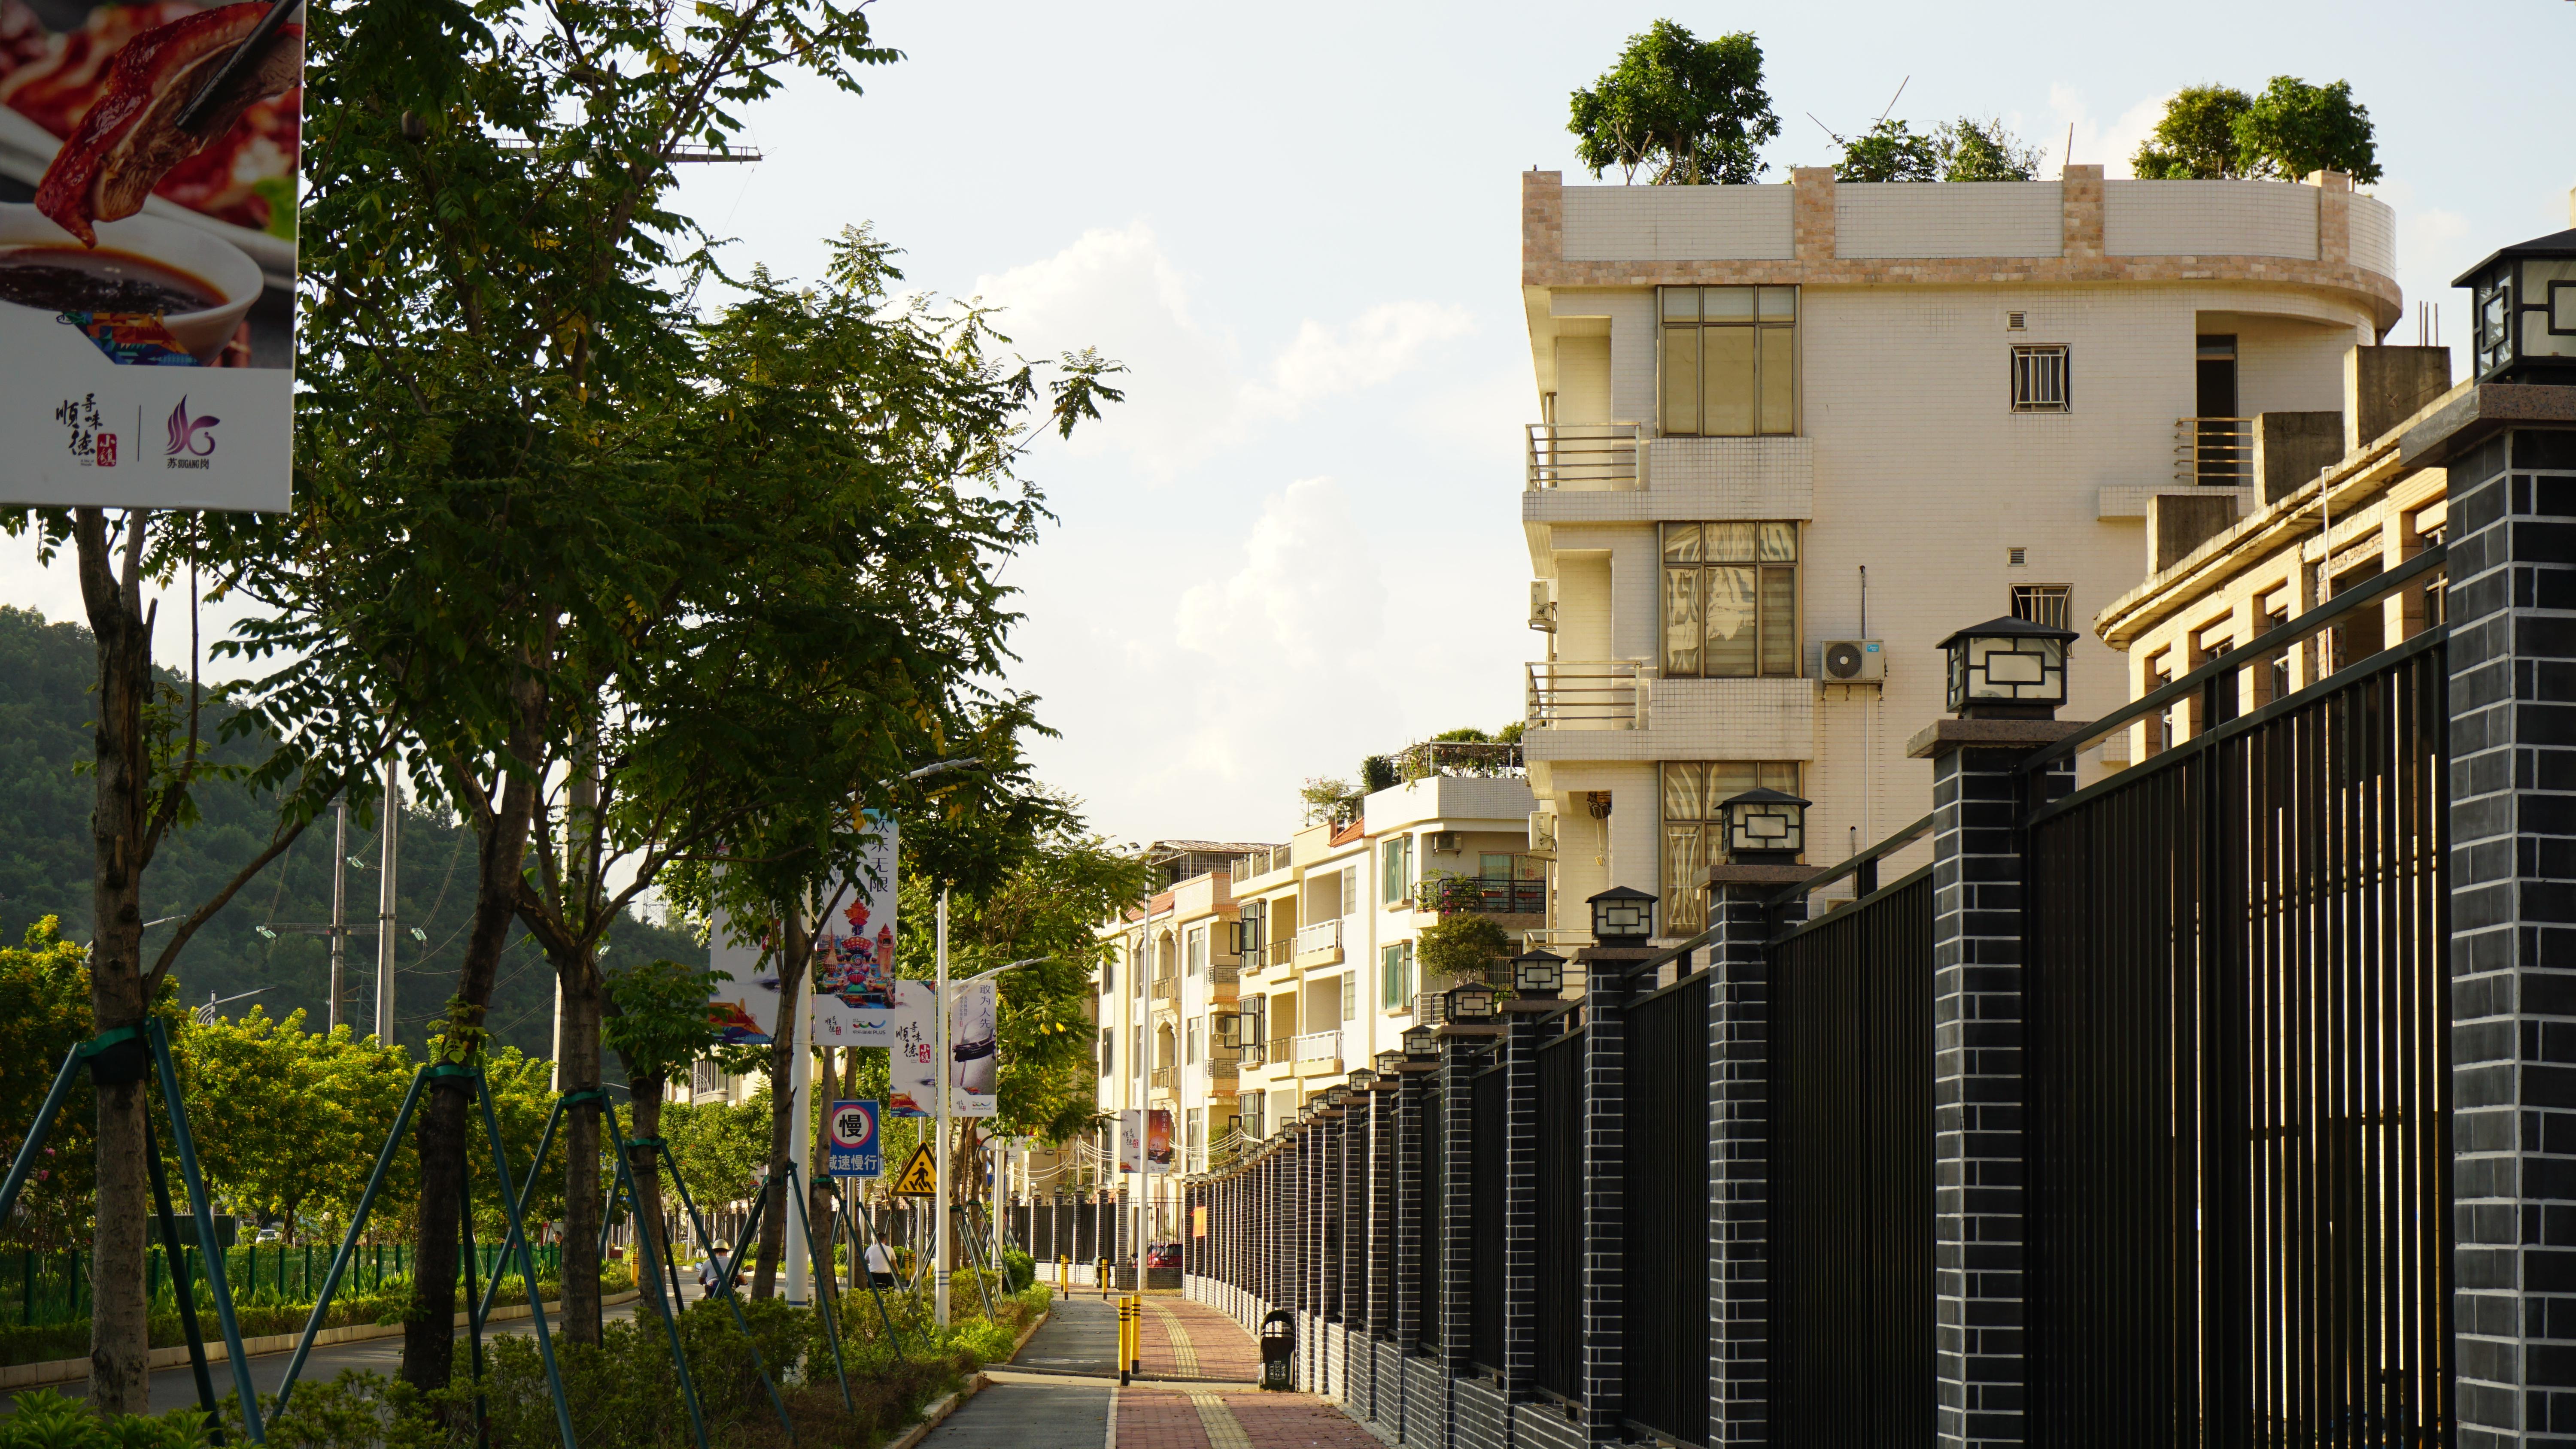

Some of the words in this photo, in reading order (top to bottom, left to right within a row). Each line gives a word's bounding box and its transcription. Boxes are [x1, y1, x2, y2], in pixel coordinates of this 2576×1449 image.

[178, 459, 199, 468] SUGANG
[980, 985, 990, 1028] 敢为人先
[839, 1114, 863, 1138] 慢
